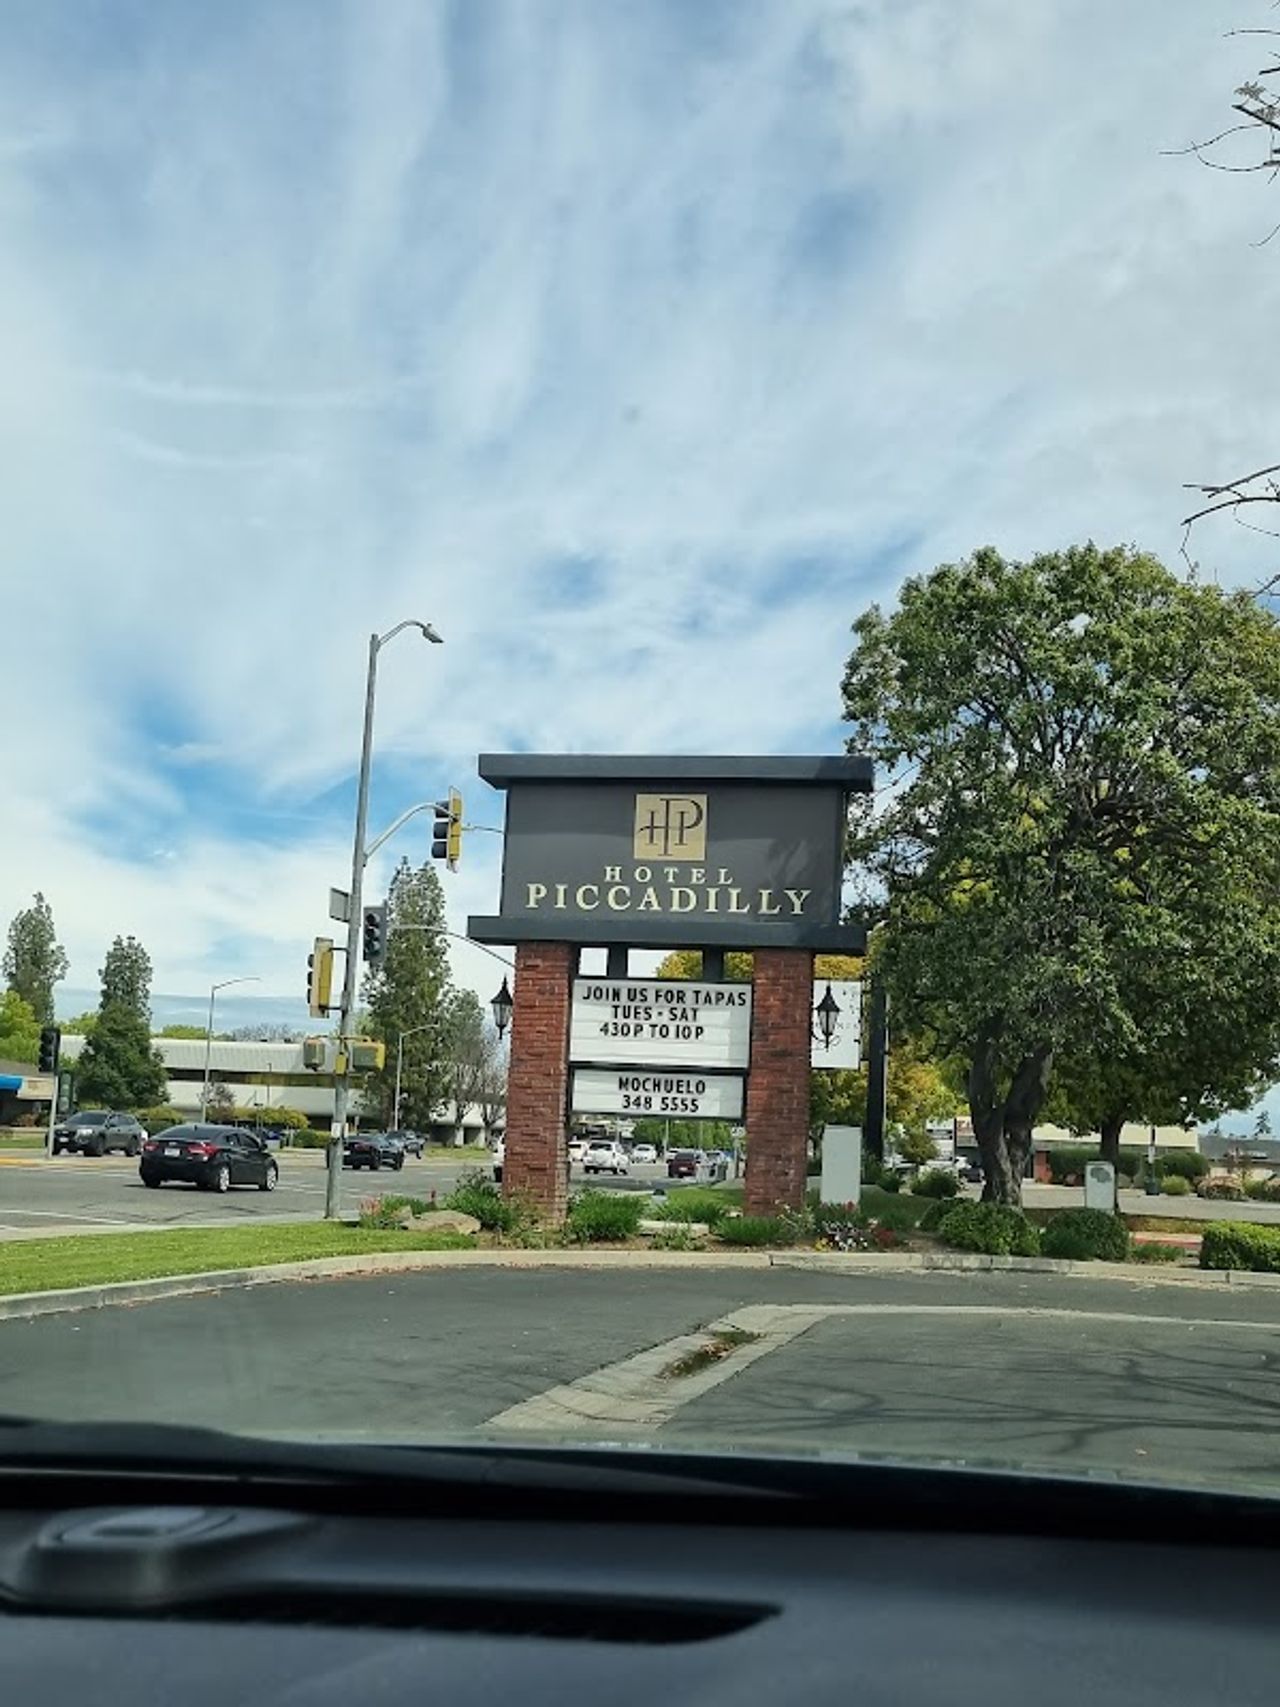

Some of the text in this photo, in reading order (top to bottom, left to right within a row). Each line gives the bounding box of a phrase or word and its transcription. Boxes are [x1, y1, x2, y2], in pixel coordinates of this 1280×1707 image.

[604, 866, 733, 885] HOTEL
[525, 884, 812, 915] PICCADILLY
[582, 986, 747, 1006] JOIN US FOR TAPAS
[612, 1005, 652, 1021] TUES
[669, 1007, 700, 1022] SAT
[599, 1022, 644, 1037] 430P
[649, 1024, 669, 1039] TO
[618, 1077, 706, 1095] MOCHUELO
[622, 1094, 699, 1112] 348 5555
